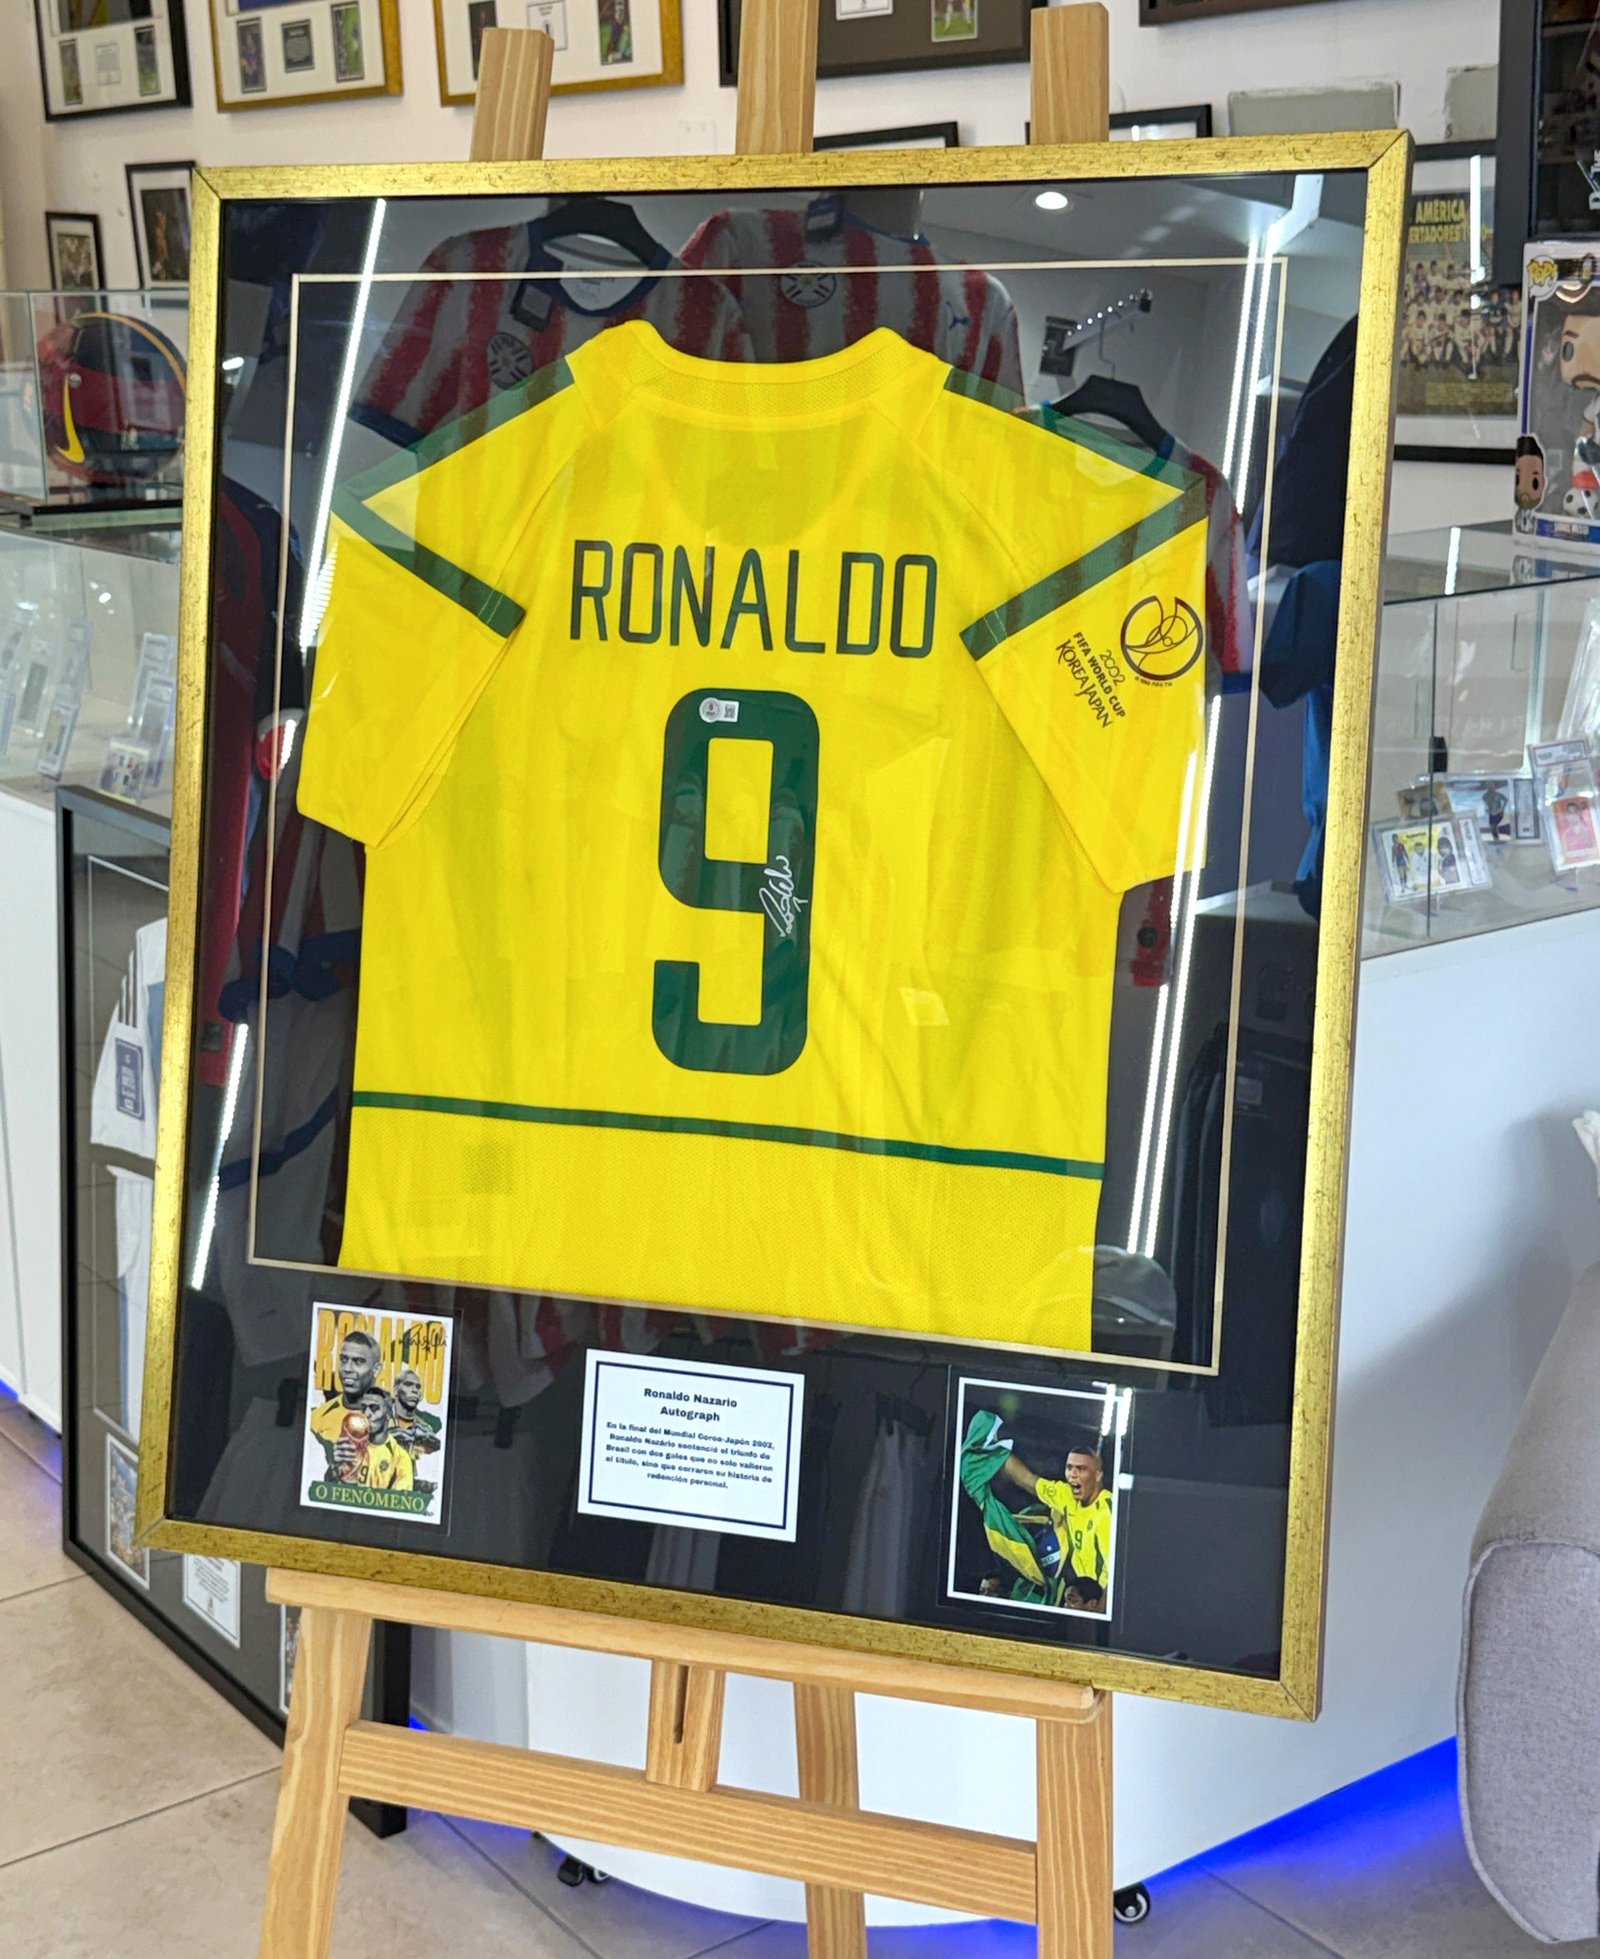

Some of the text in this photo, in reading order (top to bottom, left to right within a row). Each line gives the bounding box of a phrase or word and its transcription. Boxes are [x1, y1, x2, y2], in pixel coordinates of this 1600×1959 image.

[570, 540, 938, 659] RONALDO
[1073, 631, 1126, 718] FIFA WORLD CUP
[1099, 649, 1126, 687] 2002
[1056, 639, 1114, 729] KOREA JAPAN
[652, 688, 820, 1076] 9
[314, 1308, 446, 1405] ROALDO
[644, 1388, 738, 1408] Ronaldo Nazario
[660, 1406, 720, 1422] Autograph
[606, 1421, 617, 1429] En
[629, 1424, 647, 1432] final
[664, 1428, 696, 1439] Mundial
[606, 1444, 630, 1453] Brasil
[665, 1452, 688, 1460] goles
[739, 1462, 773, 1471] valieron
[609, 1433, 642, 1443] Ronaldo
[678, 1443, 718, 1453] sentenció
[730, 1448, 758, 1458] triunfo
[647, 1473, 728, 1489] redención personal.
[678, 1466, 714, 1475] cerraron
[728, 1471, 760, 1482] historia
[315, 1485, 425, 1512] O FENÔMENO
[1075, 1530, 1083, 1550] 9
